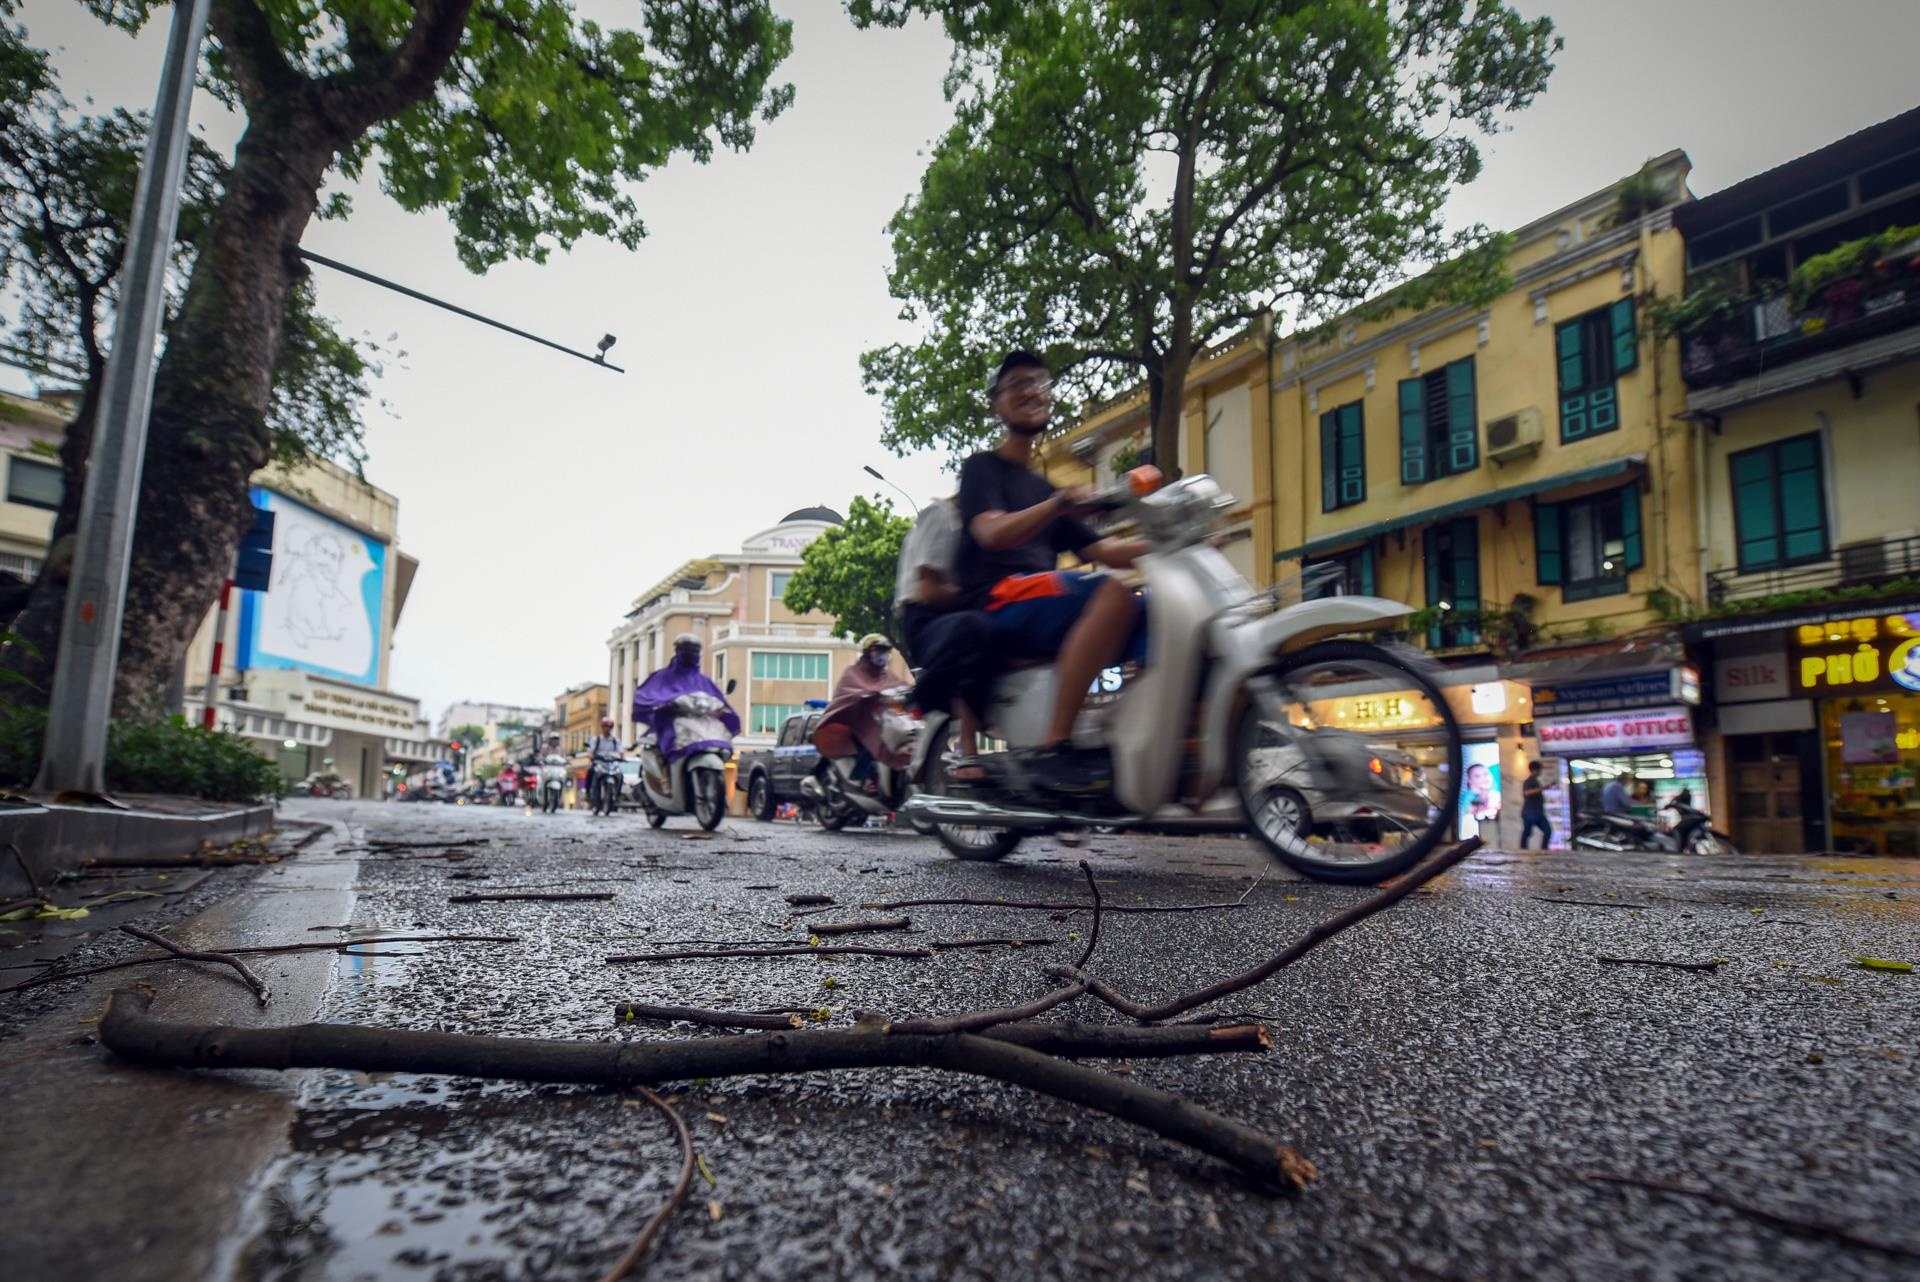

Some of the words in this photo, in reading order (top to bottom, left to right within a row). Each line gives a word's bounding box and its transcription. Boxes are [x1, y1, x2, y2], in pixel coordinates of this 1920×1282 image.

[1726, 664, 1777, 687] Silk
[1801, 643, 1880, 688] PHỞ
[1539, 724, 1618, 743] BOOKING
[1622, 717, 1689, 737] OFFICE
